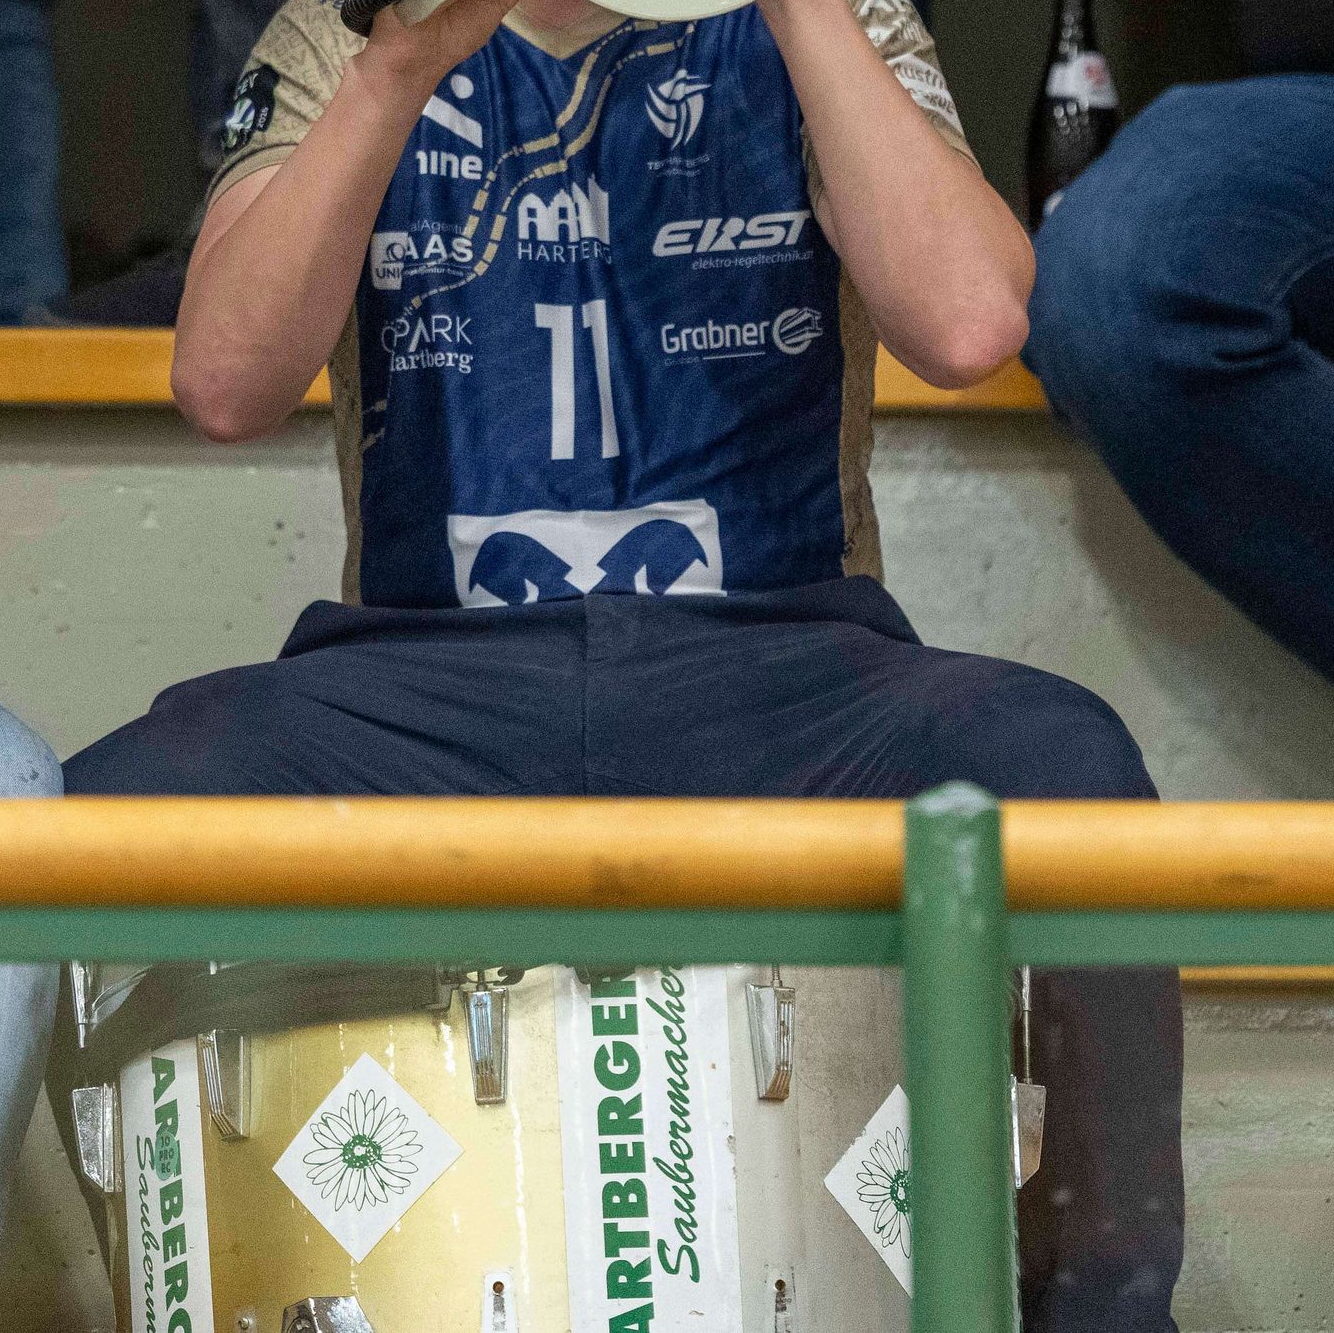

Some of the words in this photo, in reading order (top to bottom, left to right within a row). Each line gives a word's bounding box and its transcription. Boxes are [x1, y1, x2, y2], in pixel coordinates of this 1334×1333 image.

[404, 234, 473, 263] AAS
[535, 299, 620, 461] 11
[661, 319, 771, 354] Grabner
[645, 966, 702, 1284] Saubermache
